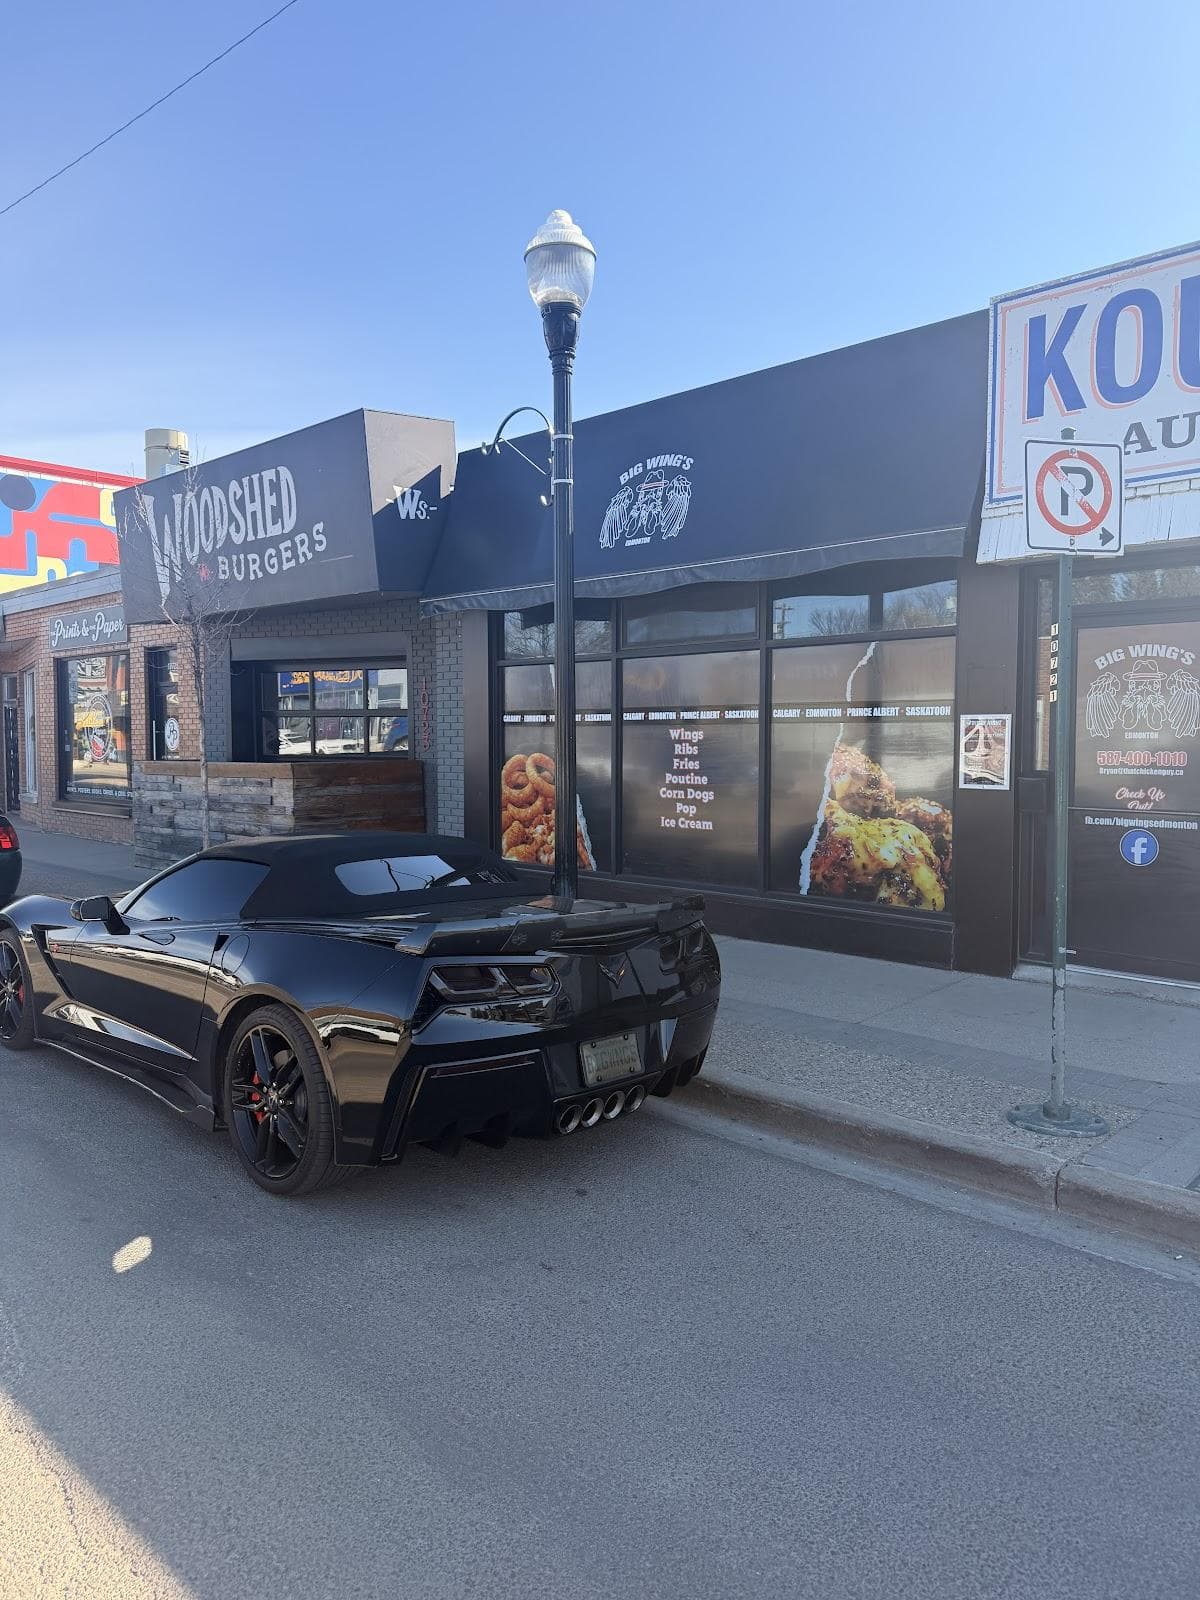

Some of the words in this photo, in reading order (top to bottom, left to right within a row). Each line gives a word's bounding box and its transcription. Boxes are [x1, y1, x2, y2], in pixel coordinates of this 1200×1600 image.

[619, 462, 643, 486] BIG
[646, 454, 694, 471] WING'S
[142, 465, 298, 606] WOODSHED
[218, 521, 328, 582] BURGERS
[51, 619, 81, 647] Prints
[81, 619, 90, 636] &
[92, 611, 125, 642] Paper
[1049, 623, 1059, 702] 10721
[1094, 648, 1126, 670] BIG
[1128, 643, 1197, 666] WING'S
[622, 712, 645, 721] CALGARY
[648, 711, 677, 721] EDMONTON
[680, 711, 700, 720] PRINCE
[700, 710, 721, 719] ALBERT
[724, 709, 760, 719] SASKATOON
[772, 708, 801, 718] CALGARY
[805, 707, 842, 718] EDMONTON
[846, 706, 872, 717] PRINCE
[872, 706, 900, 717] ALBERT
[905, 704, 951, 717] SASKATOON
[669, 728, 704, 743] Wings
[1124, 731, 1159, 740] EDMONTON
[674, 743, 699, 755] Ribs
[673, 758, 700, 770] Fries
[1097, 750, 1188, 767] 587-400-1010
[665, 773, 708, 785] Poutine
[660, 787, 685, 799] Corn
[687, 788, 715, 803] Dogs
[1115, 787, 1146, 800] Check
[1147, 787, 1166, 802] Us
[676, 802, 697, 817] Pop
[660, 816, 677, 828] Ice
[678, 817, 713, 830] Cream
[1084, 815, 1199, 830] fb.com/bigwingsedmonton
